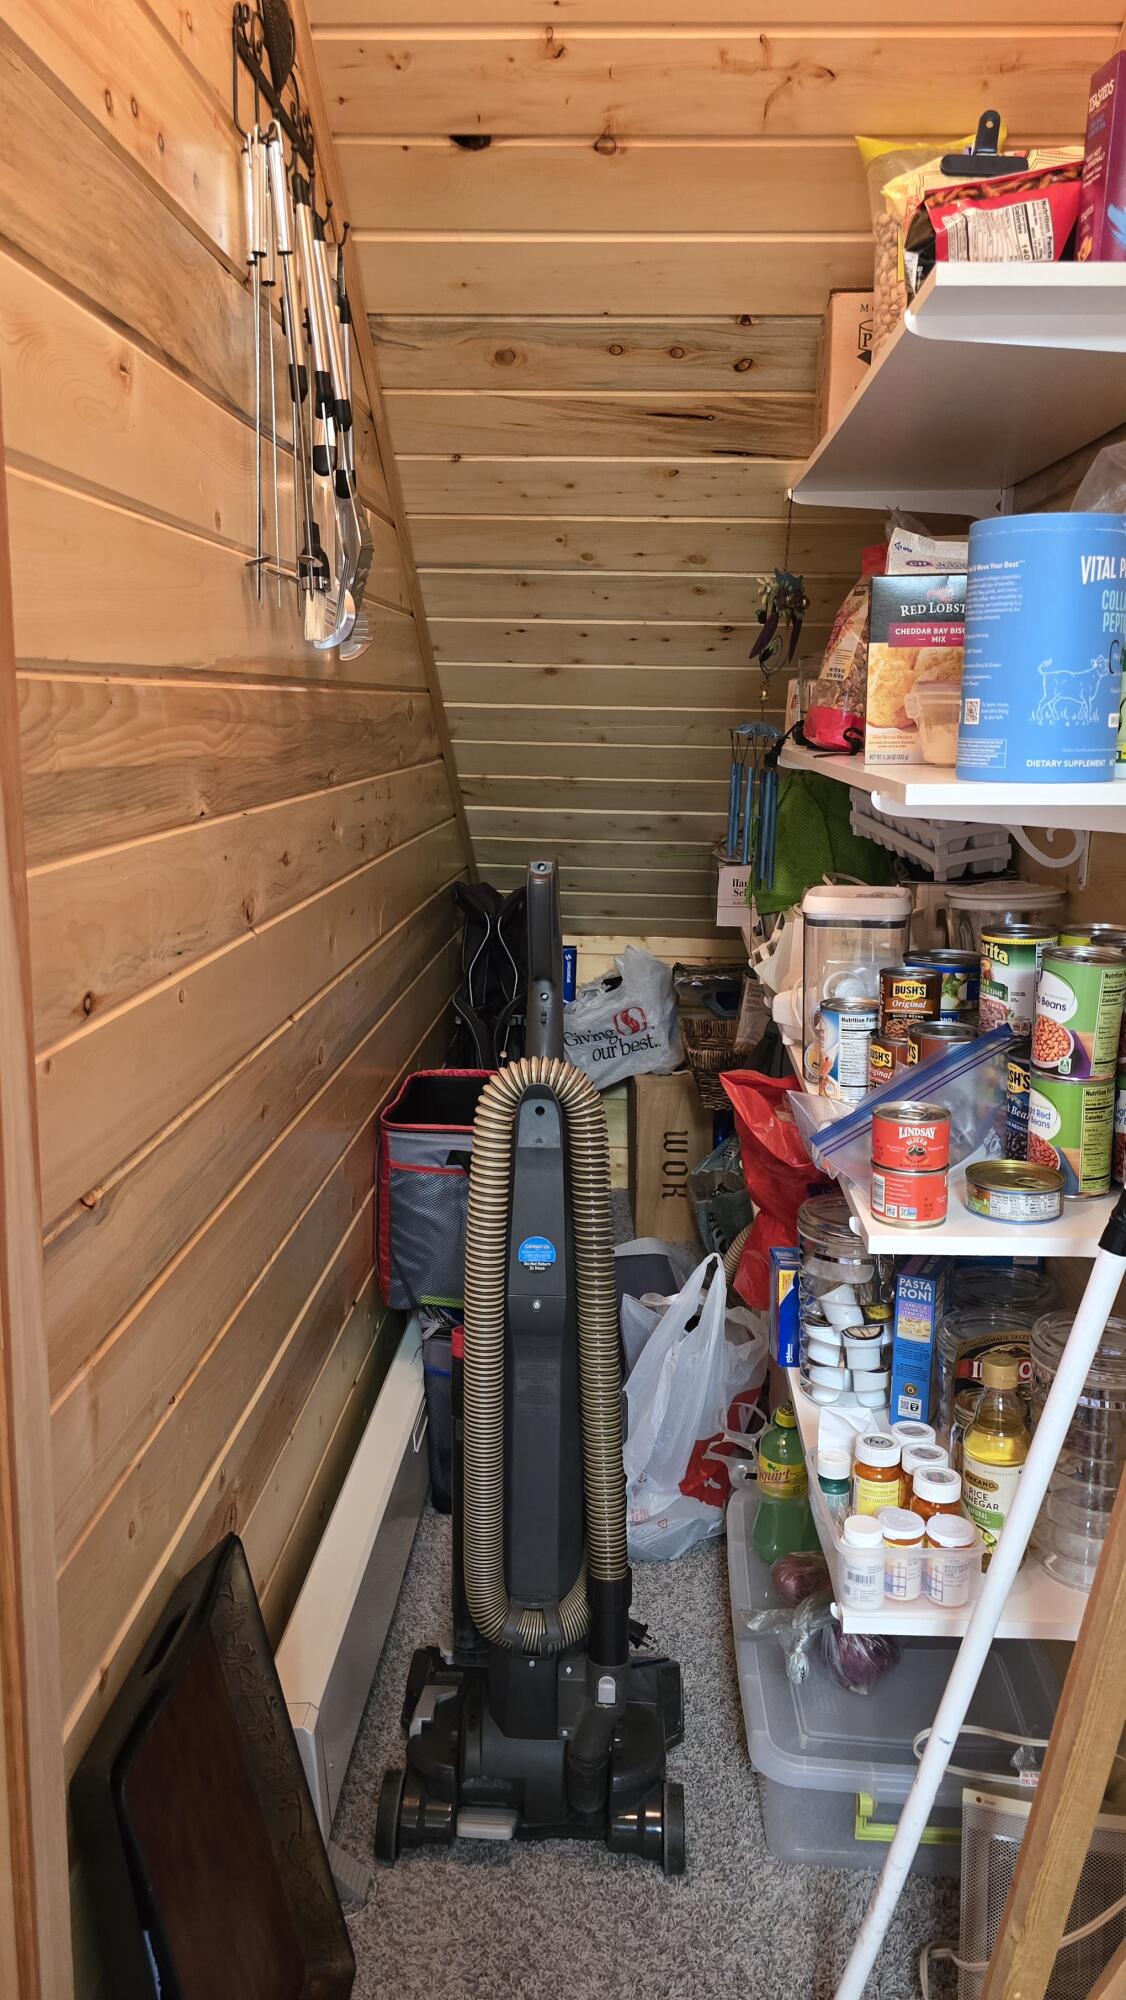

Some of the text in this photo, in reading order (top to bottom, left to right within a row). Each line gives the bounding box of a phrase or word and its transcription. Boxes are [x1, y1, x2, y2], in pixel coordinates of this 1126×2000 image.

[1014, 205, 1023, 234] Calories
[1040, 200, 1051, 233] Nutrition
[1080, 555, 1117, 585] VITAL
[900, 604, 927, 617] RED
[895, 627, 932, 635] CHEDDAR
[933, 627, 948, 635] BAY
[1026, 760, 1062, 768] DIETARY
[1063, 760, 1107, 768] SUPPLEMENT
[895, 985, 925, 995] BUSH'S
[892, 999, 927, 1008] Original
[1041, 996, 1067, 1012] Beans
[563, 1030, 619, 1046] Giving
[592, 1045, 618, 1062] our
[1036, 1107, 1051, 1120] Red
[898, 1126, 937, 1139] LINDSAY
[905, 1137, 928, 1146] SLICED
[662, 1130, 688, 1199] WOK
[899, 1277, 932, 1291] PASTA
[898, 1287, 932, 1302] RONI
[968, 1486, 989, 1502] RICE
